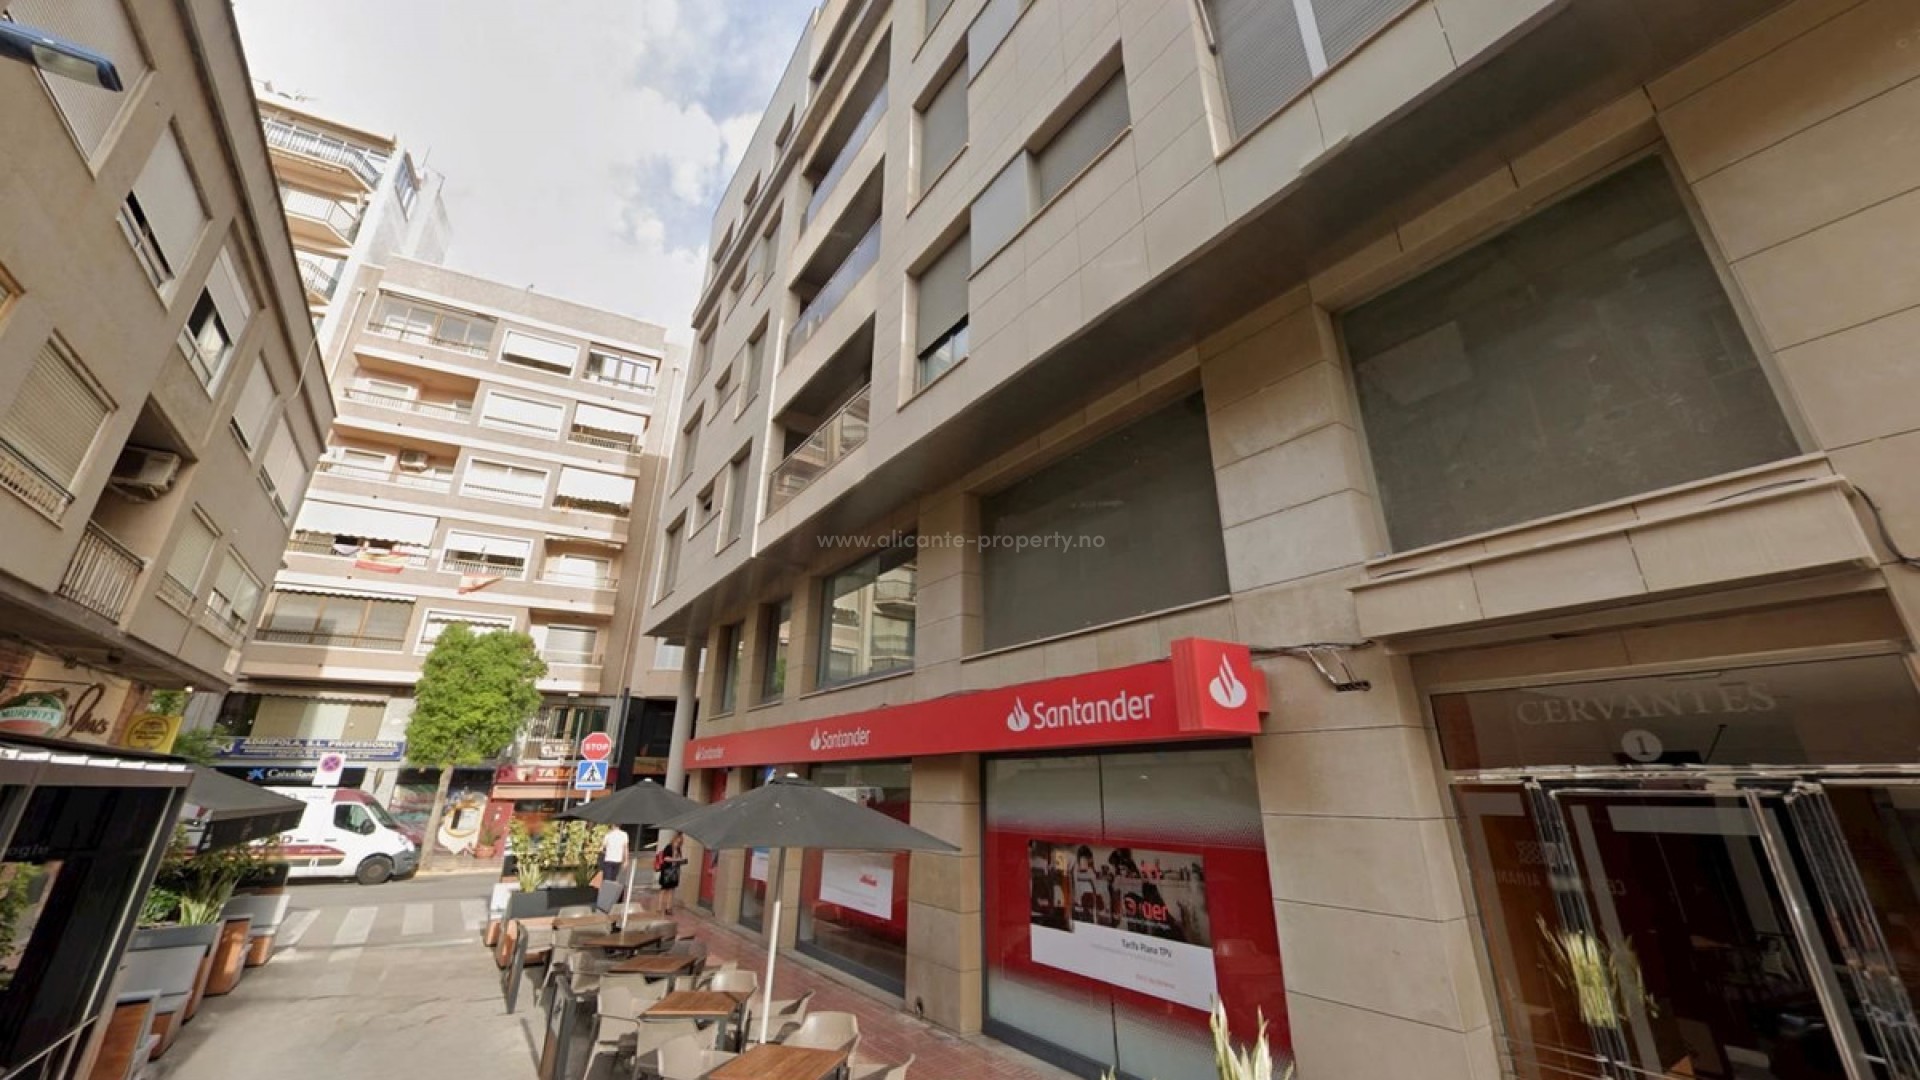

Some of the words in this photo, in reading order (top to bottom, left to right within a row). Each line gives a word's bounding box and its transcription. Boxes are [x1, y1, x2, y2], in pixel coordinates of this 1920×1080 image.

[1032, 689, 1155, 731] Santander
[1516, 682, 1777, 726] CERVANTES
[585, 743, 609, 751] STOP
[820, 726, 872, 750] Santander
[1637, 735, 1652, 756] 1
